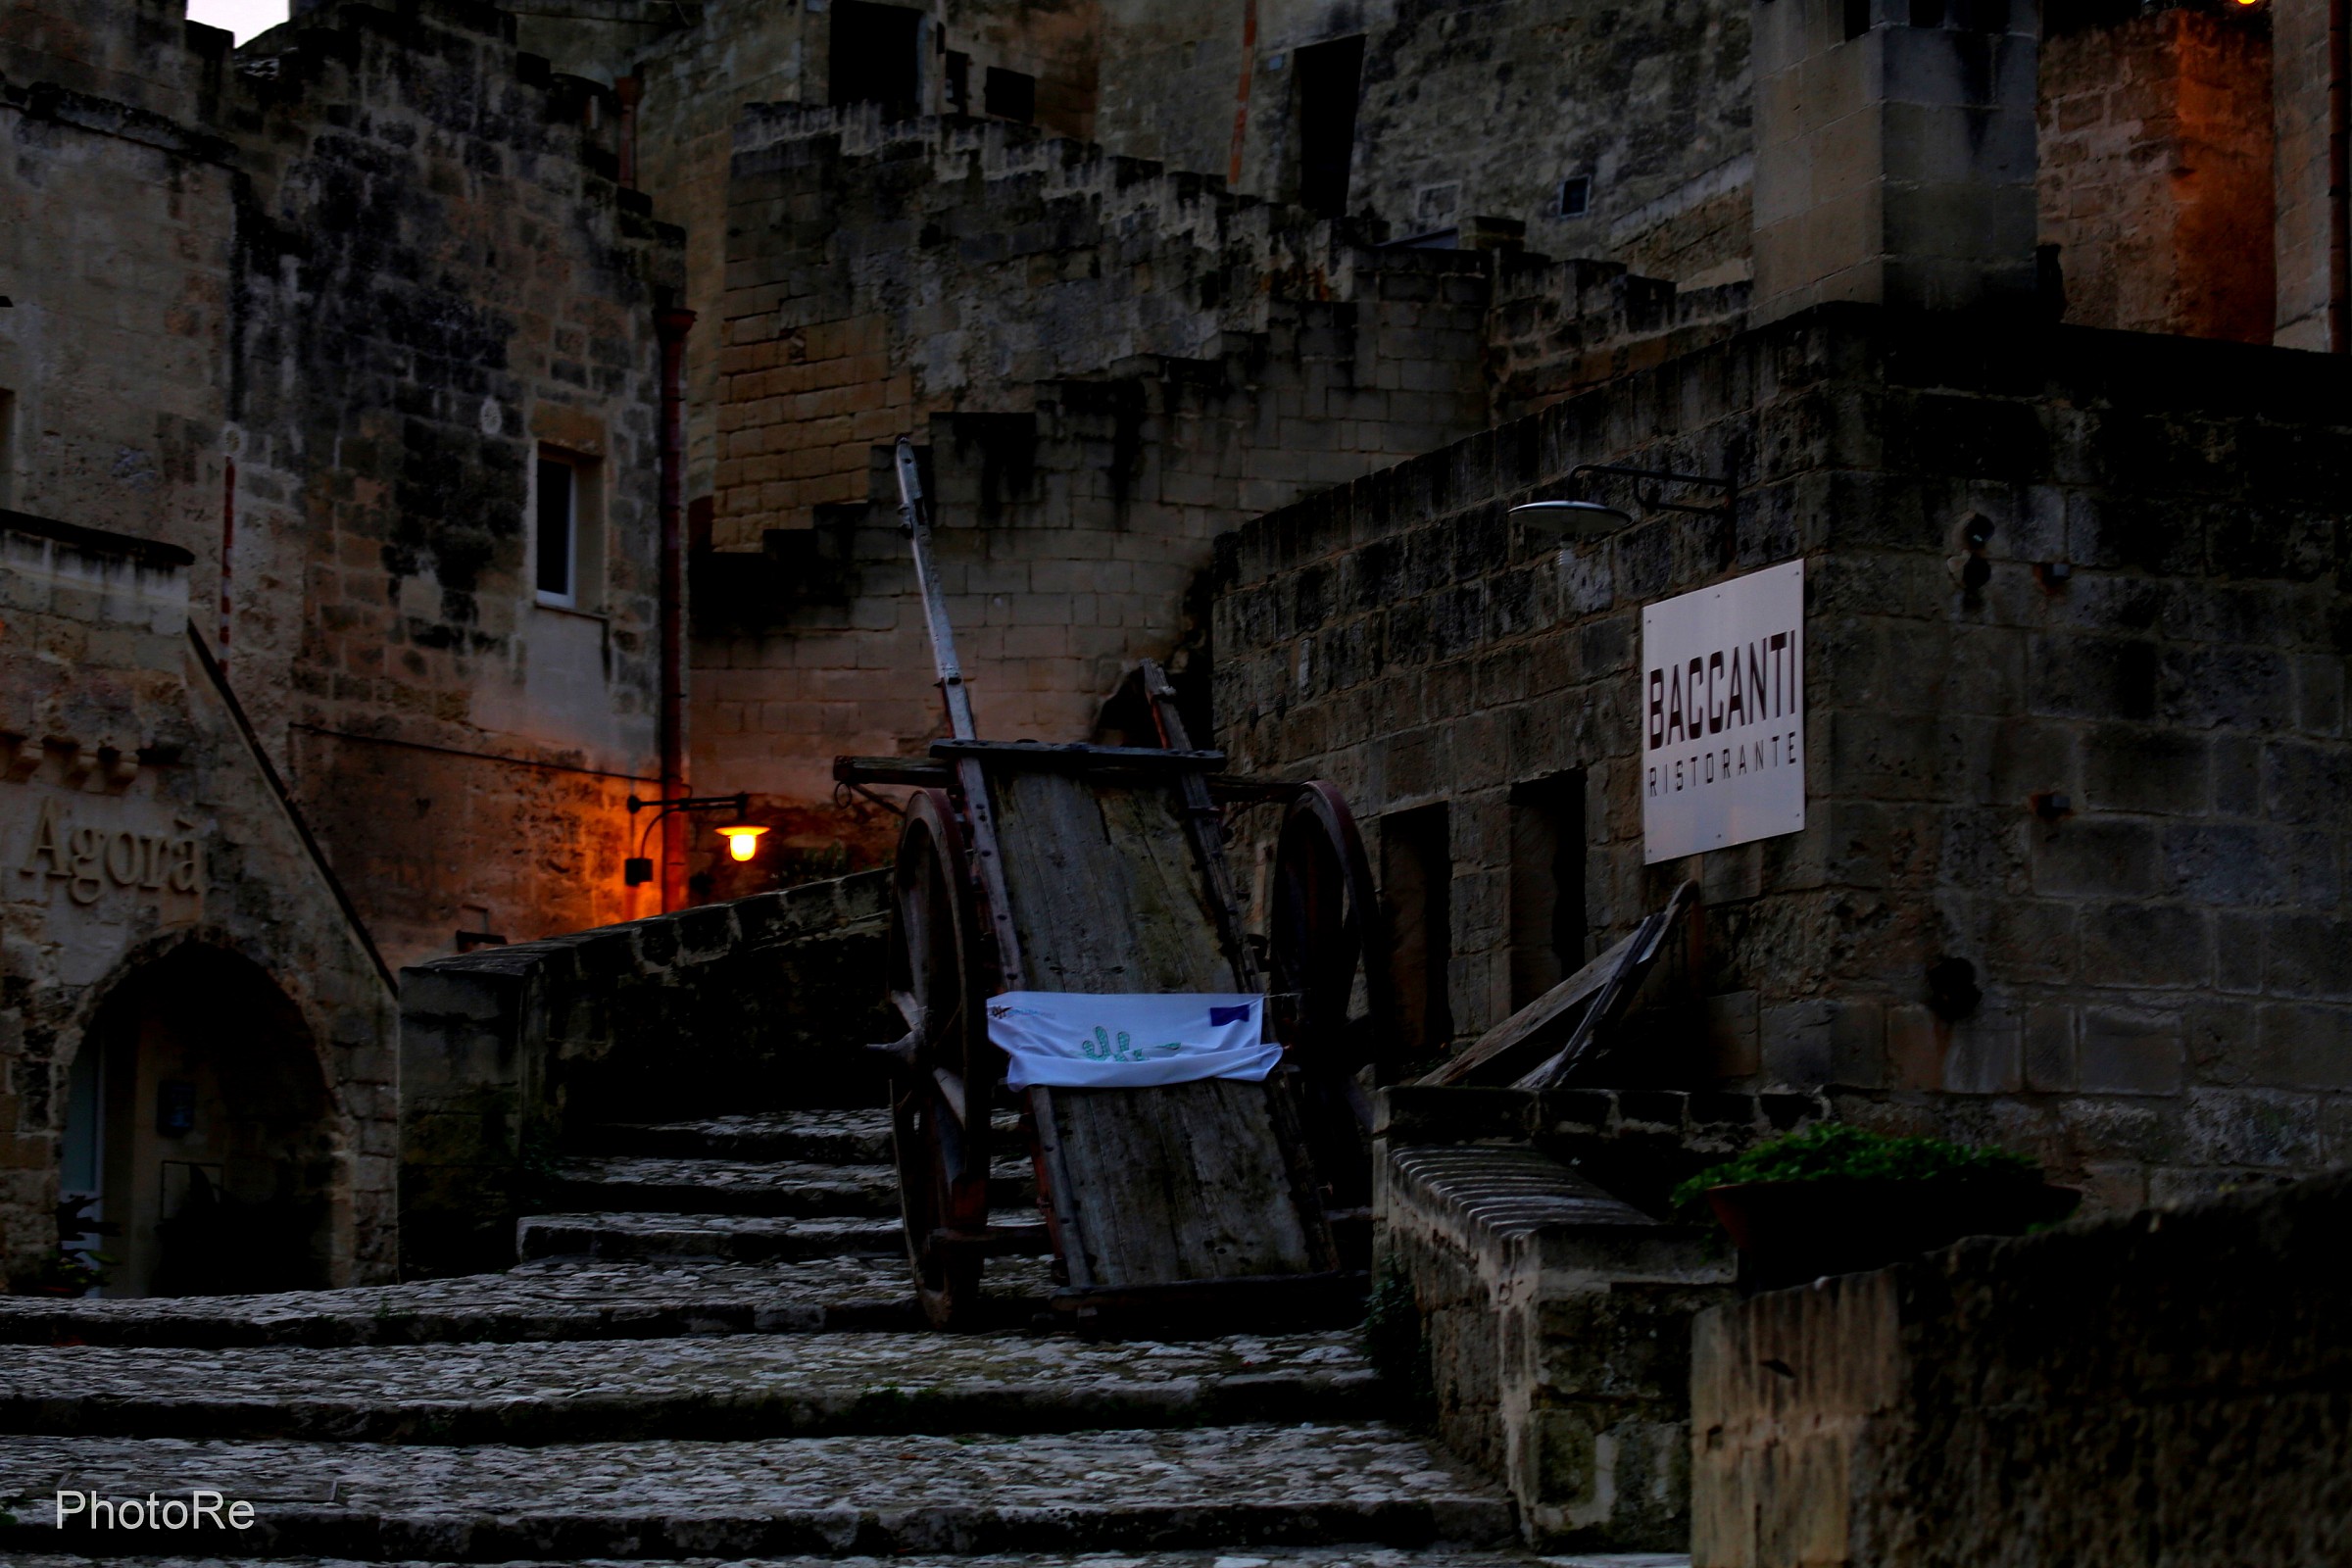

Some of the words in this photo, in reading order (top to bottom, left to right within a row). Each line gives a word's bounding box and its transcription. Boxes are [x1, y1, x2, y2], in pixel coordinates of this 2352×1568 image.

[1649, 630, 1795, 751] BACCANTI
[1649, 731, 1796, 797] RISTORANTE
[19, 796, 202, 906] Agorà
